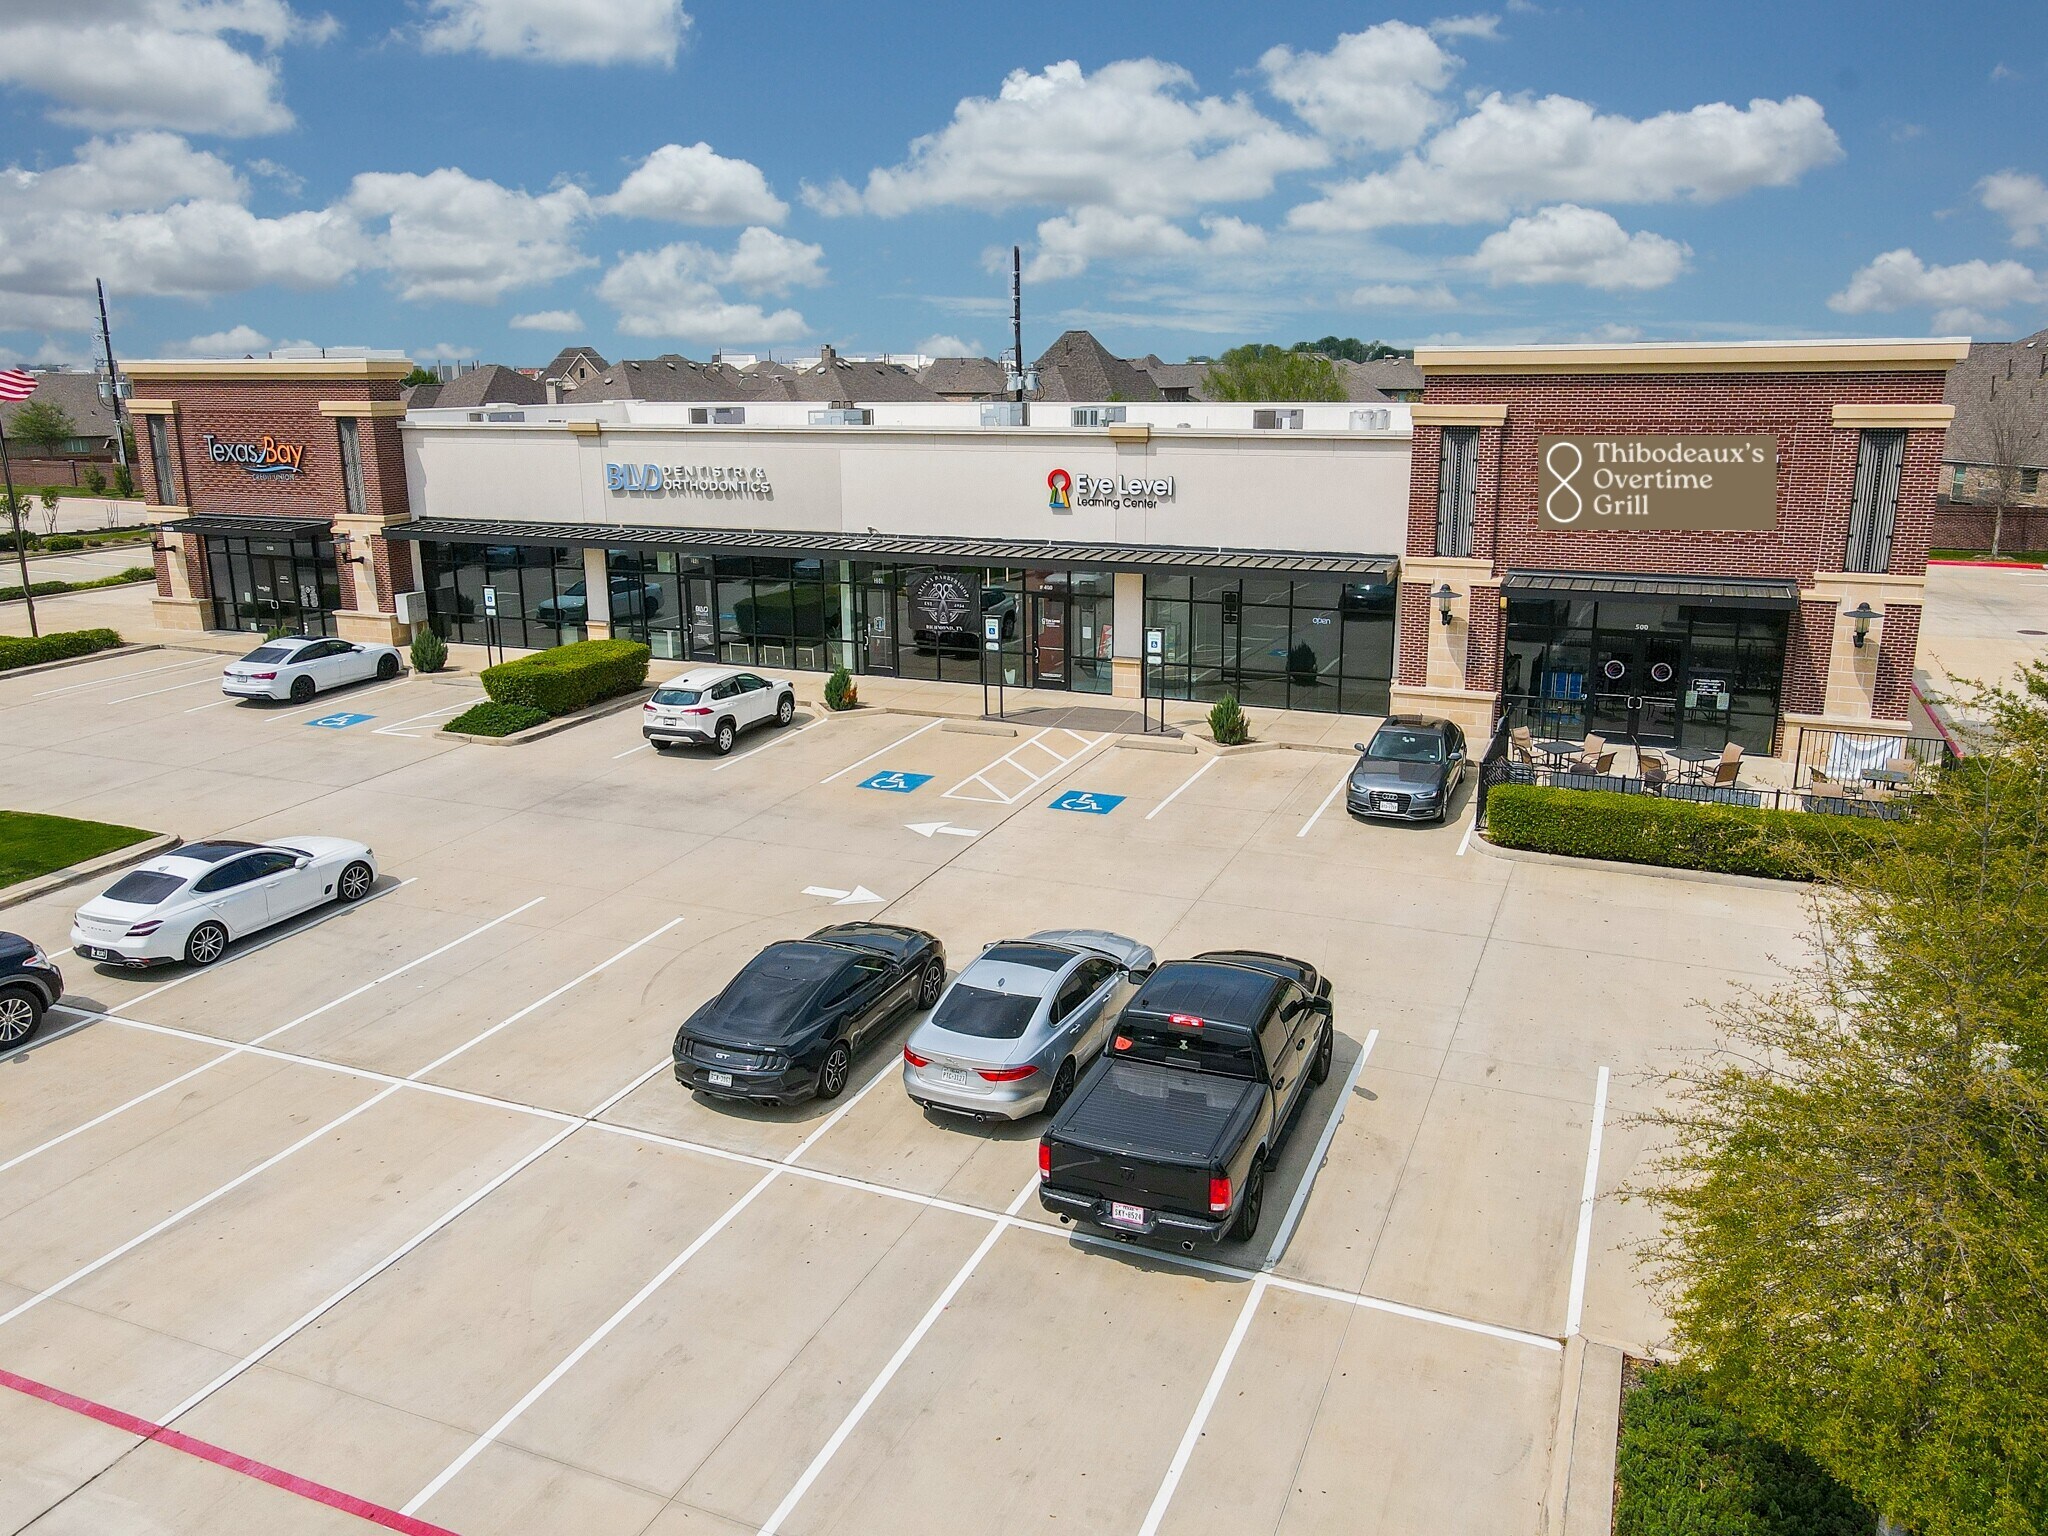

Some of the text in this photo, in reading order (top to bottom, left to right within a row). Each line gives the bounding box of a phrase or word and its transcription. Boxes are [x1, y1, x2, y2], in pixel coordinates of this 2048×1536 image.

[203, 434, 303, 472] Texas Bay
[1593, 442, 1765, 463] Thibodeaux's
[606, 463, 662, 491] BLVD
[662, 465, 752, 478] DENTISTRY
[1593, 468, 1713, 489] Overtime
[662, 479, 771, 493] ORTHODONTICS
[1076, 474, 1174, 498] Eye Level
[1077, 497, 1157, 509] Learning Center
[1593, 494, 1649, 515] Grill
[715, 1052, 731, 1060] GT
